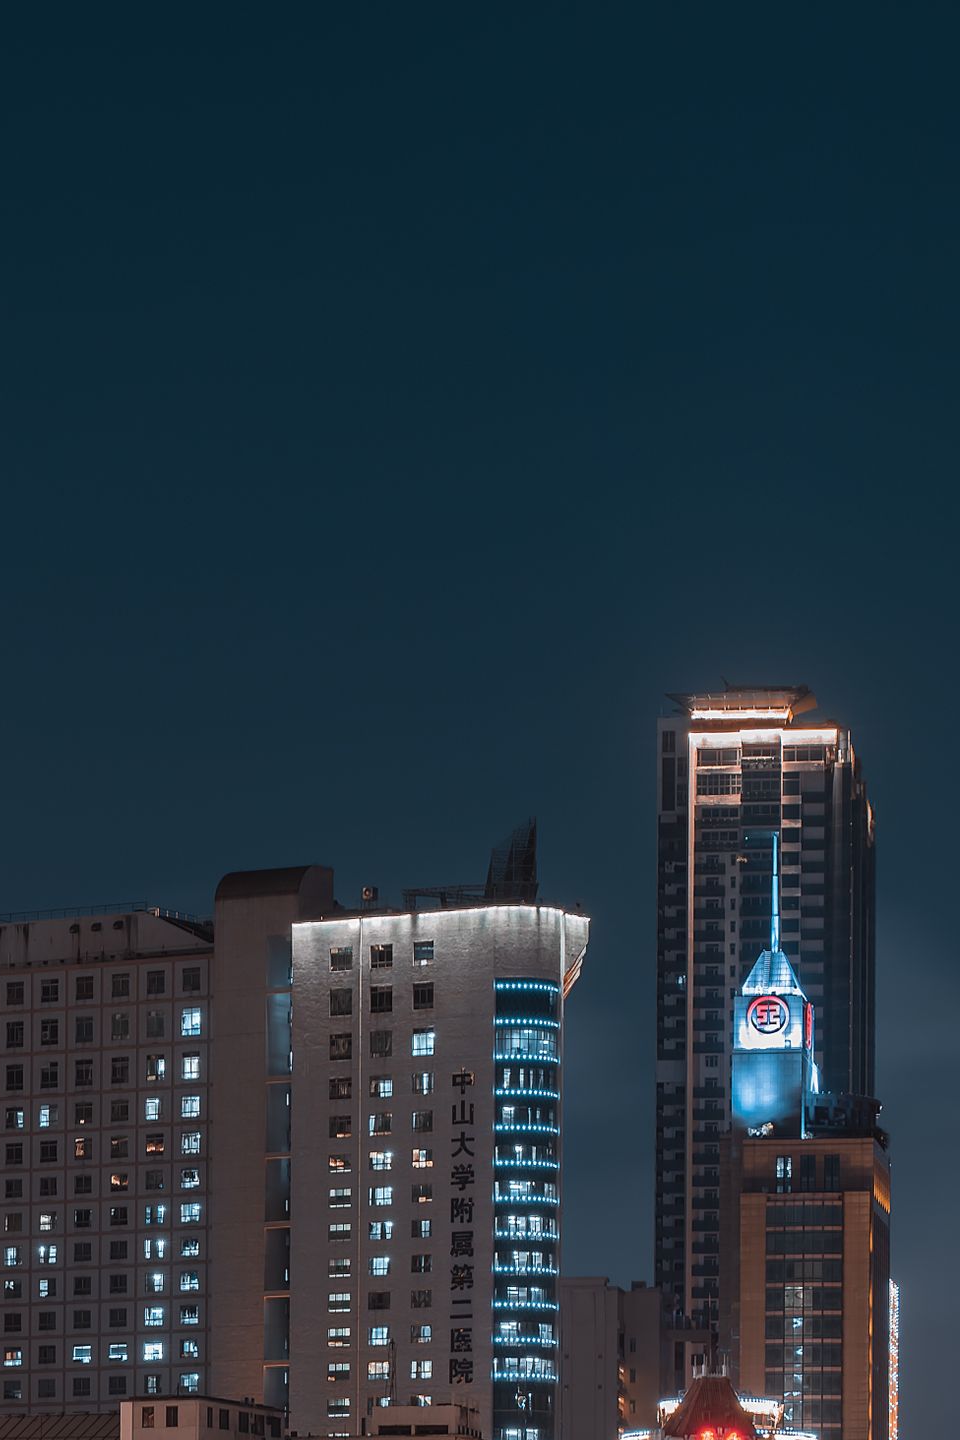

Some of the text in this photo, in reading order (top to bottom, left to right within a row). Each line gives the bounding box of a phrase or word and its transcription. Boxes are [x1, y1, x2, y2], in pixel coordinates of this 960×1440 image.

[449, 1067, 475, 1384] 中山大学附属第二医院
